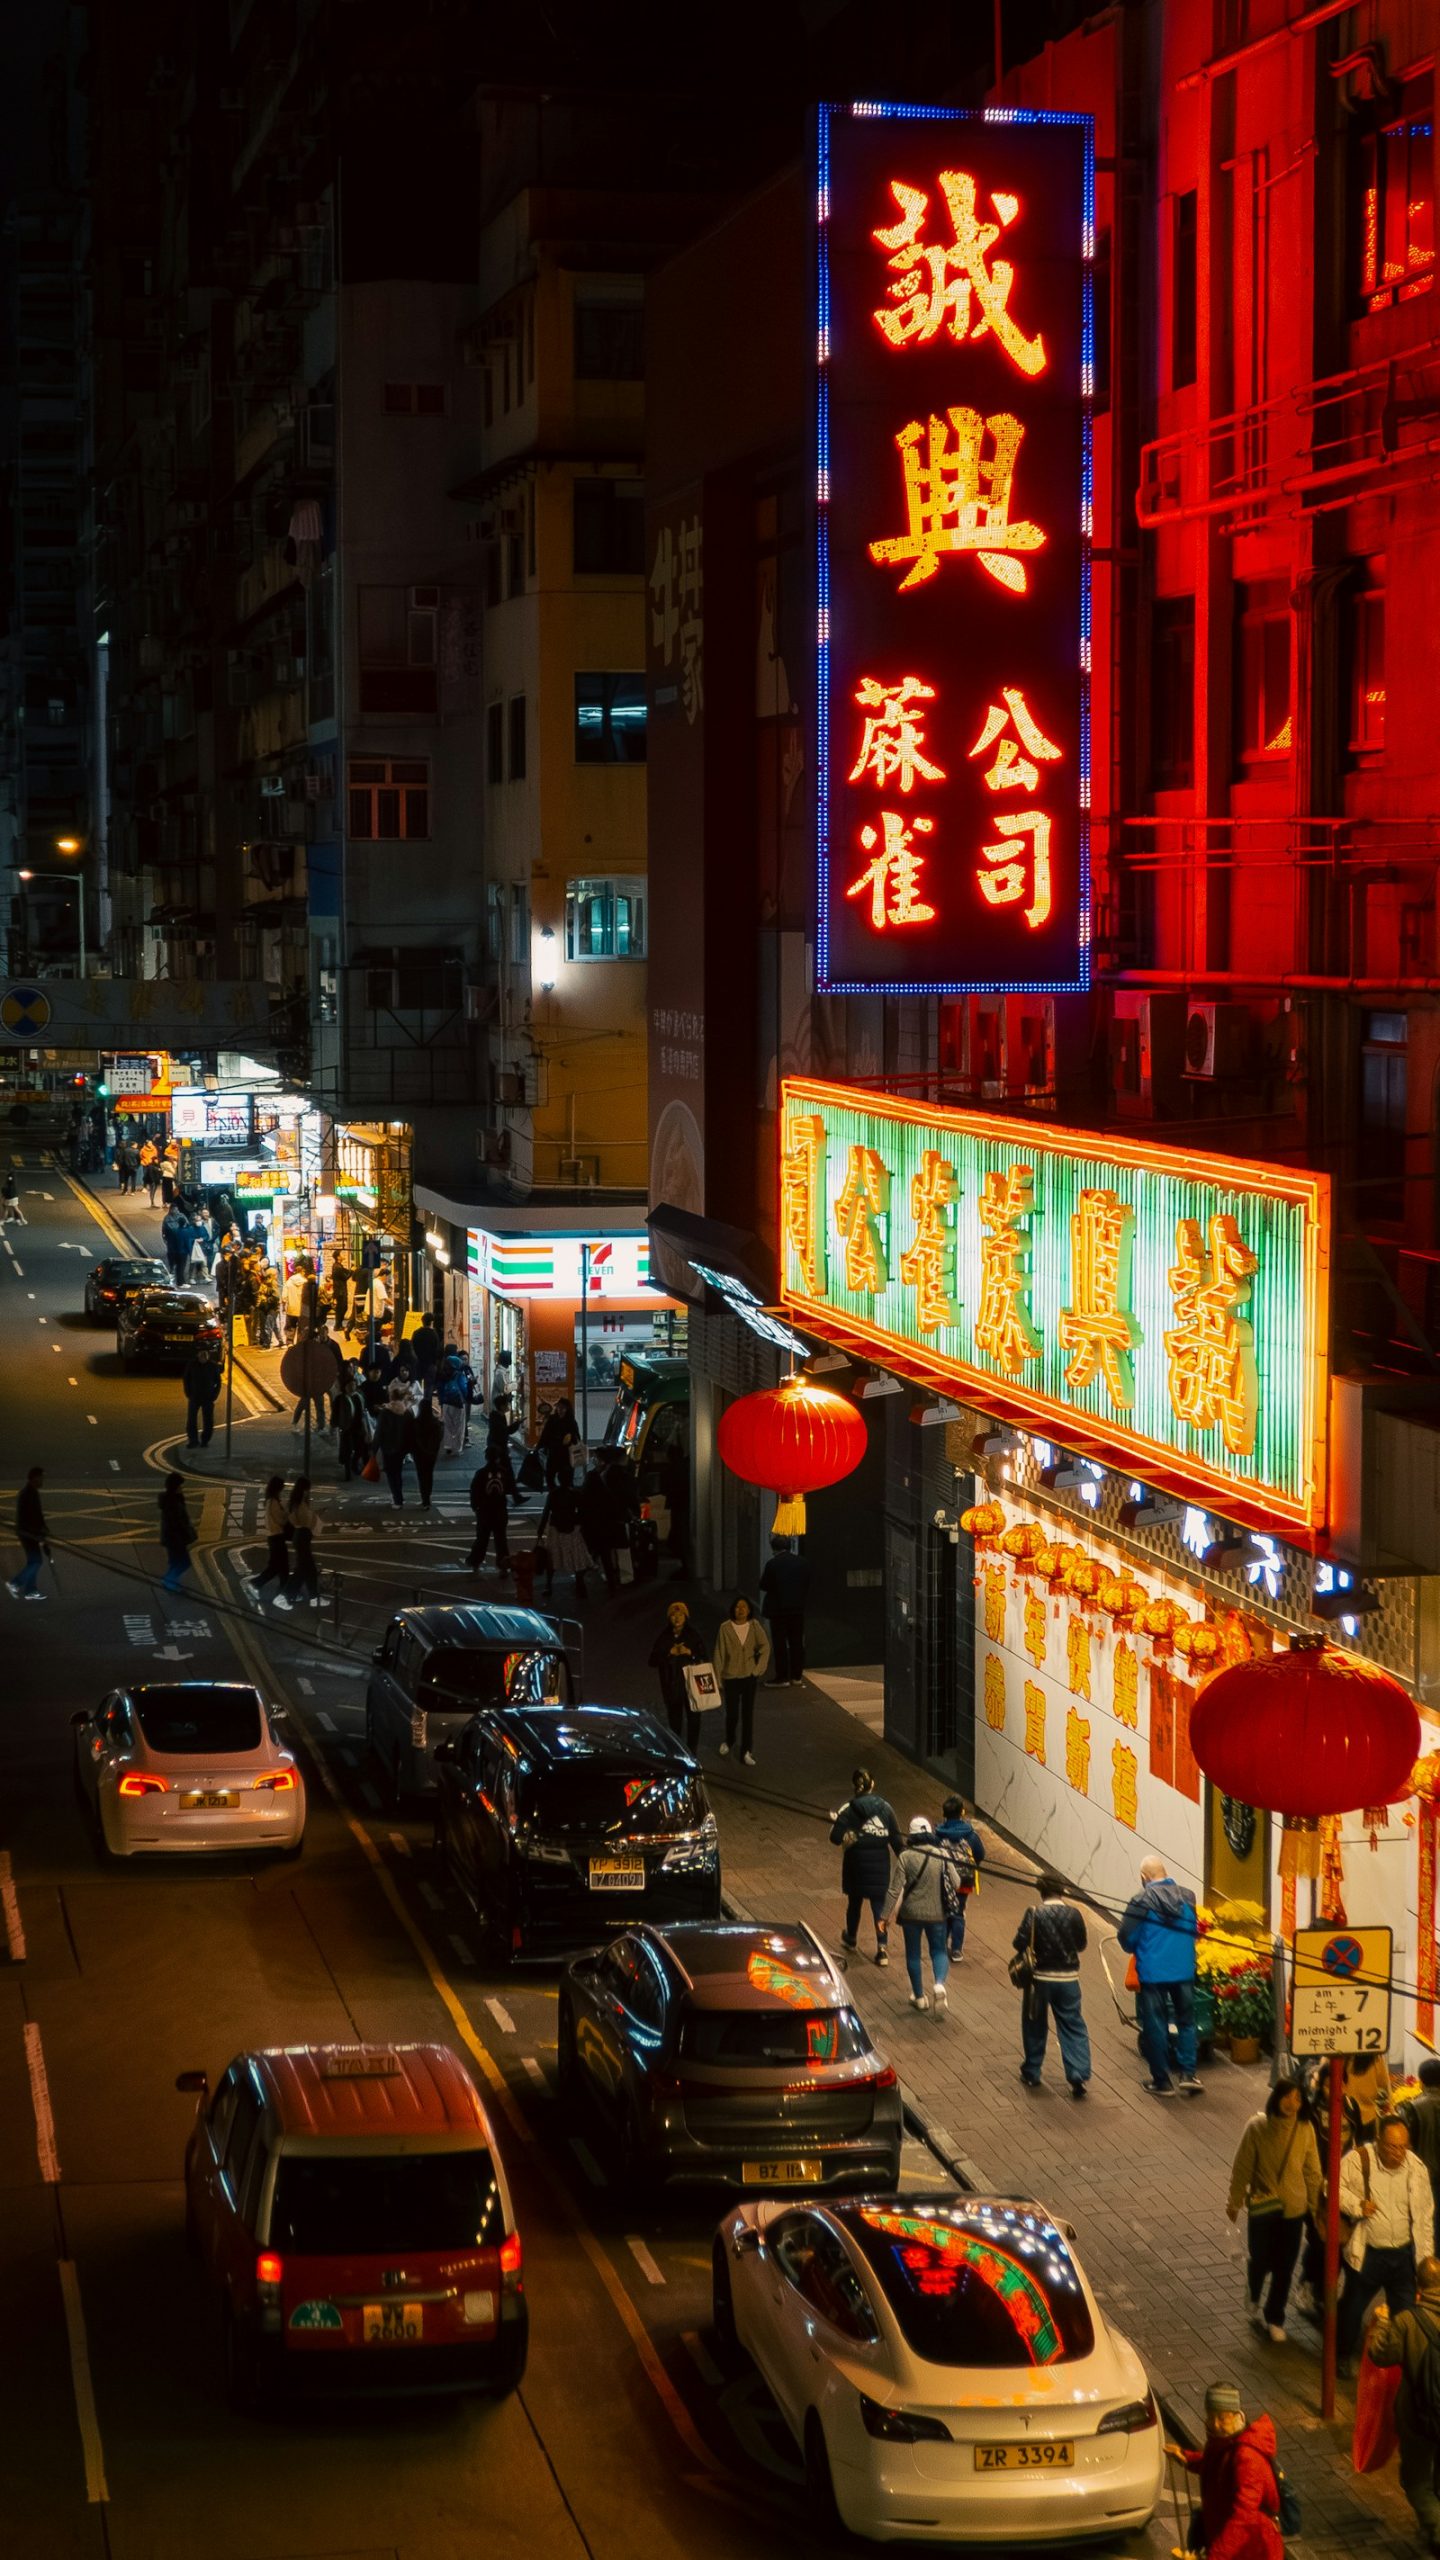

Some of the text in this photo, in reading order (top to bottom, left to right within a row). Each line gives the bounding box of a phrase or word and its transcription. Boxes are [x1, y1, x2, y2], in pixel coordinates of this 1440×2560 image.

[868, 169, 1048, 594] 誠興
[968, 686, 1063, 930] 公司
[577, 1265, 615, 1276] EEVEn
[579, 1242, 613, 1291] 7
[1309, 2000, 1338, 2014] 上午
[1315, 1990, 1371, 2013] am 7
[1298, 2025, 1382, 2050] midnight 12
[1309, 2037, 1336, 2051] 午夜
[332, 2055, 396, 2073] TAXI
[981, 2444, 1072, 2467] ZR 3394
